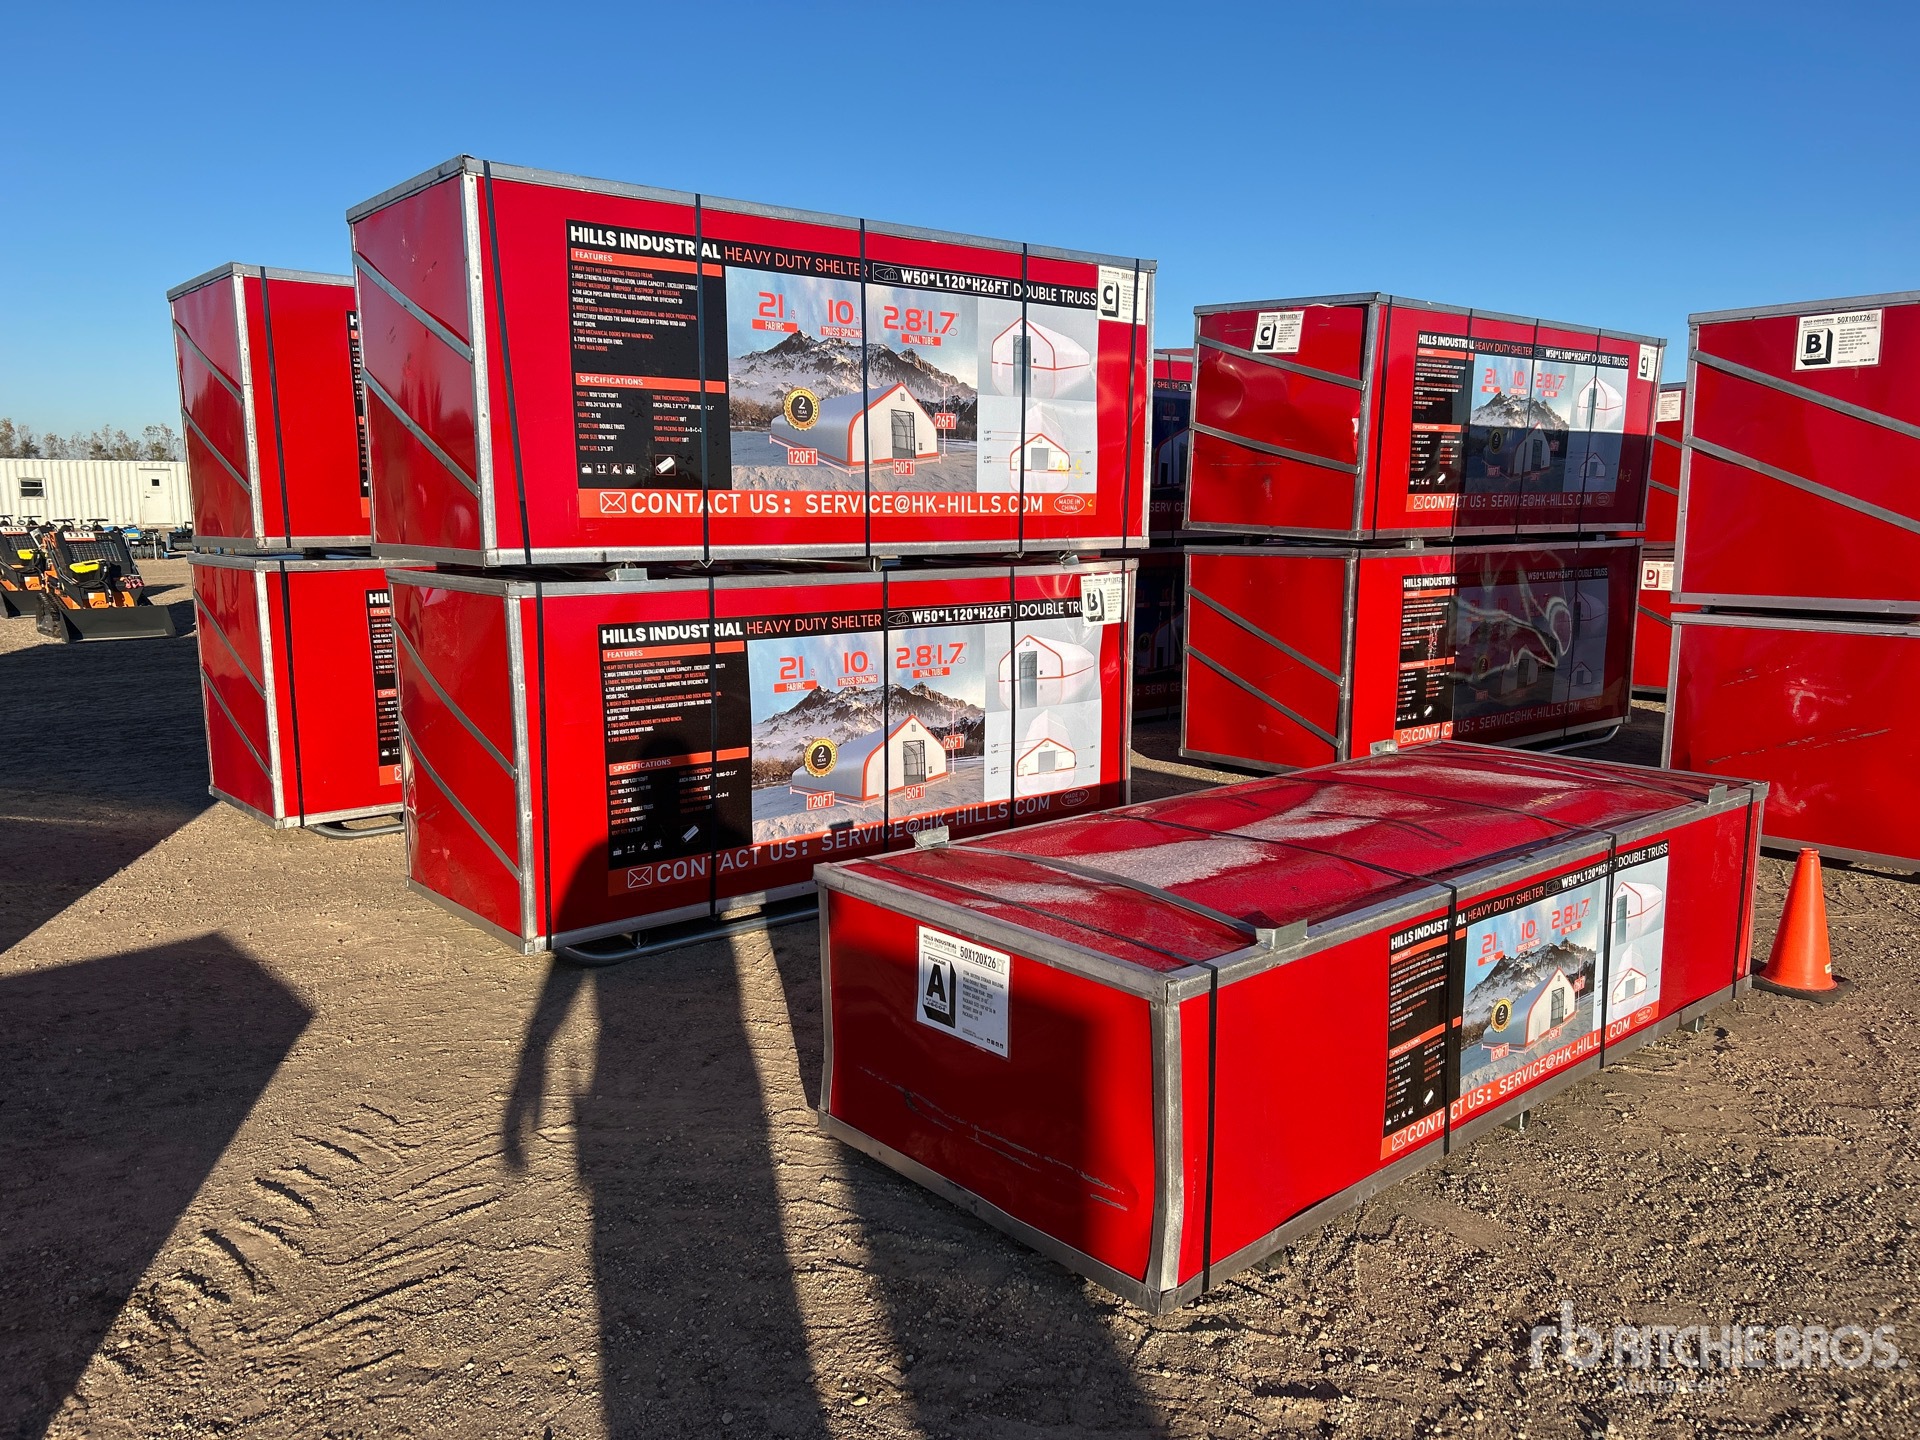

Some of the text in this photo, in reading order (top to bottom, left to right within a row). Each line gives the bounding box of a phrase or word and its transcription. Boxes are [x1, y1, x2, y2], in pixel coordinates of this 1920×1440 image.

[575, 251, 612, 262] FEATURES
[570, 226, 616, 247] HILLS
[724, 246, 771, 264] HEAVY
[776, 253, 811, 270] DUTY
[1060, 290, 1096, 306] TRUSS
[1103, 285, 1114, 304] C
[758, 292, 784, 318] 21
[828, 299, 854, 325] 10
[822, 326, 839, 336] TRUSS
[1260, 326, 1270, 342] C
[908, 336, 934, 346] OVAL TUBE
[1806, 334, 1822, 354] B
[1418, 334, 1437, 346] HILLS
[1475, 342, 1494, 352] HEAVY
[1495, 344, 1510, 353] DUTY
[1512, 345, 1532, 356] SHELTER
[1612, 356, 1628, 366] TRUSS
[580, 376, 644, 386] SPECIFICATIONS
[1484, 368, 1496, 384] 21
[1514, 371, 1524, 386] 10
[1158, 381, 1178, 390] SHELER
[798, 397, 806, 409] 2
[936, 415, 954, 428] 26FT
[790, 450, 816, 464] 120FT
[895, 461, 914, 474] 50FT
[631, 492, 1042, 514] CONTACT US: SERVICE@HK-HILLS.COM
[1646, 570, 1656, 580] D
[1404, 578, 1422, 588] HILLS
[369, 593, 390, 604] HIL
[1087, 593, 1098, 611] B
[602, 626, 646, 644] HILLS
[746, 619, 791, 635] HEAVY
[795, 616, 828, 632] DUTY
[832, 614, 882, 630] SHELTER
[1020, 602, 1064, 617] DOUBLE
[1067, 600, 1083, 614] TRU
[607, 650, 643, 658] FEATURES
[780, 656, 804, 680] 21
[844, 652, 868, 674] 10
[932, 668, 944, 676] TUBE
[838, 674, 876, 686] TRUSS SPACING
[945, 736, 962, 748] 26FT
[817, 746, 824, 757] 2
[613, 759, 670, 772] SPECIFICATIONS
[906, 786, 924, 799] 50FT
[808, 794, 833, 808] 120FT
[770, 840, 807, 862] US:
[822, 796, 1050, 851] SERVICE@HK-HILLSCOM
[1391, 931, 1414, 950] HILLS
[1414, 914, 1466, 943] INDUSTAL
[1468, 904, 1492, 921] HEAVY
[1494, 896, 1515, 914] DUTY
[1516, 886, 1544, 907] SHELTER
[1618, 850, 1646, 868] DOUBLE
[1648, 843, 1668, 858] TRUSS
[1522, 920, 1536, 938] 10
[934, 938, 956, 950] INDUSTRIAL
[1482, 932, 1496, 954] 21
[928, 956, 946, 966] PACKAGE
[926, 964, 946, 1003] A
[1500, 1006, 1504, 1016] 2
[1468, 1089, 1492, 1110] US:
[1499, 1018, 1630, 1095] SERVICE@HK-HILL.COM
